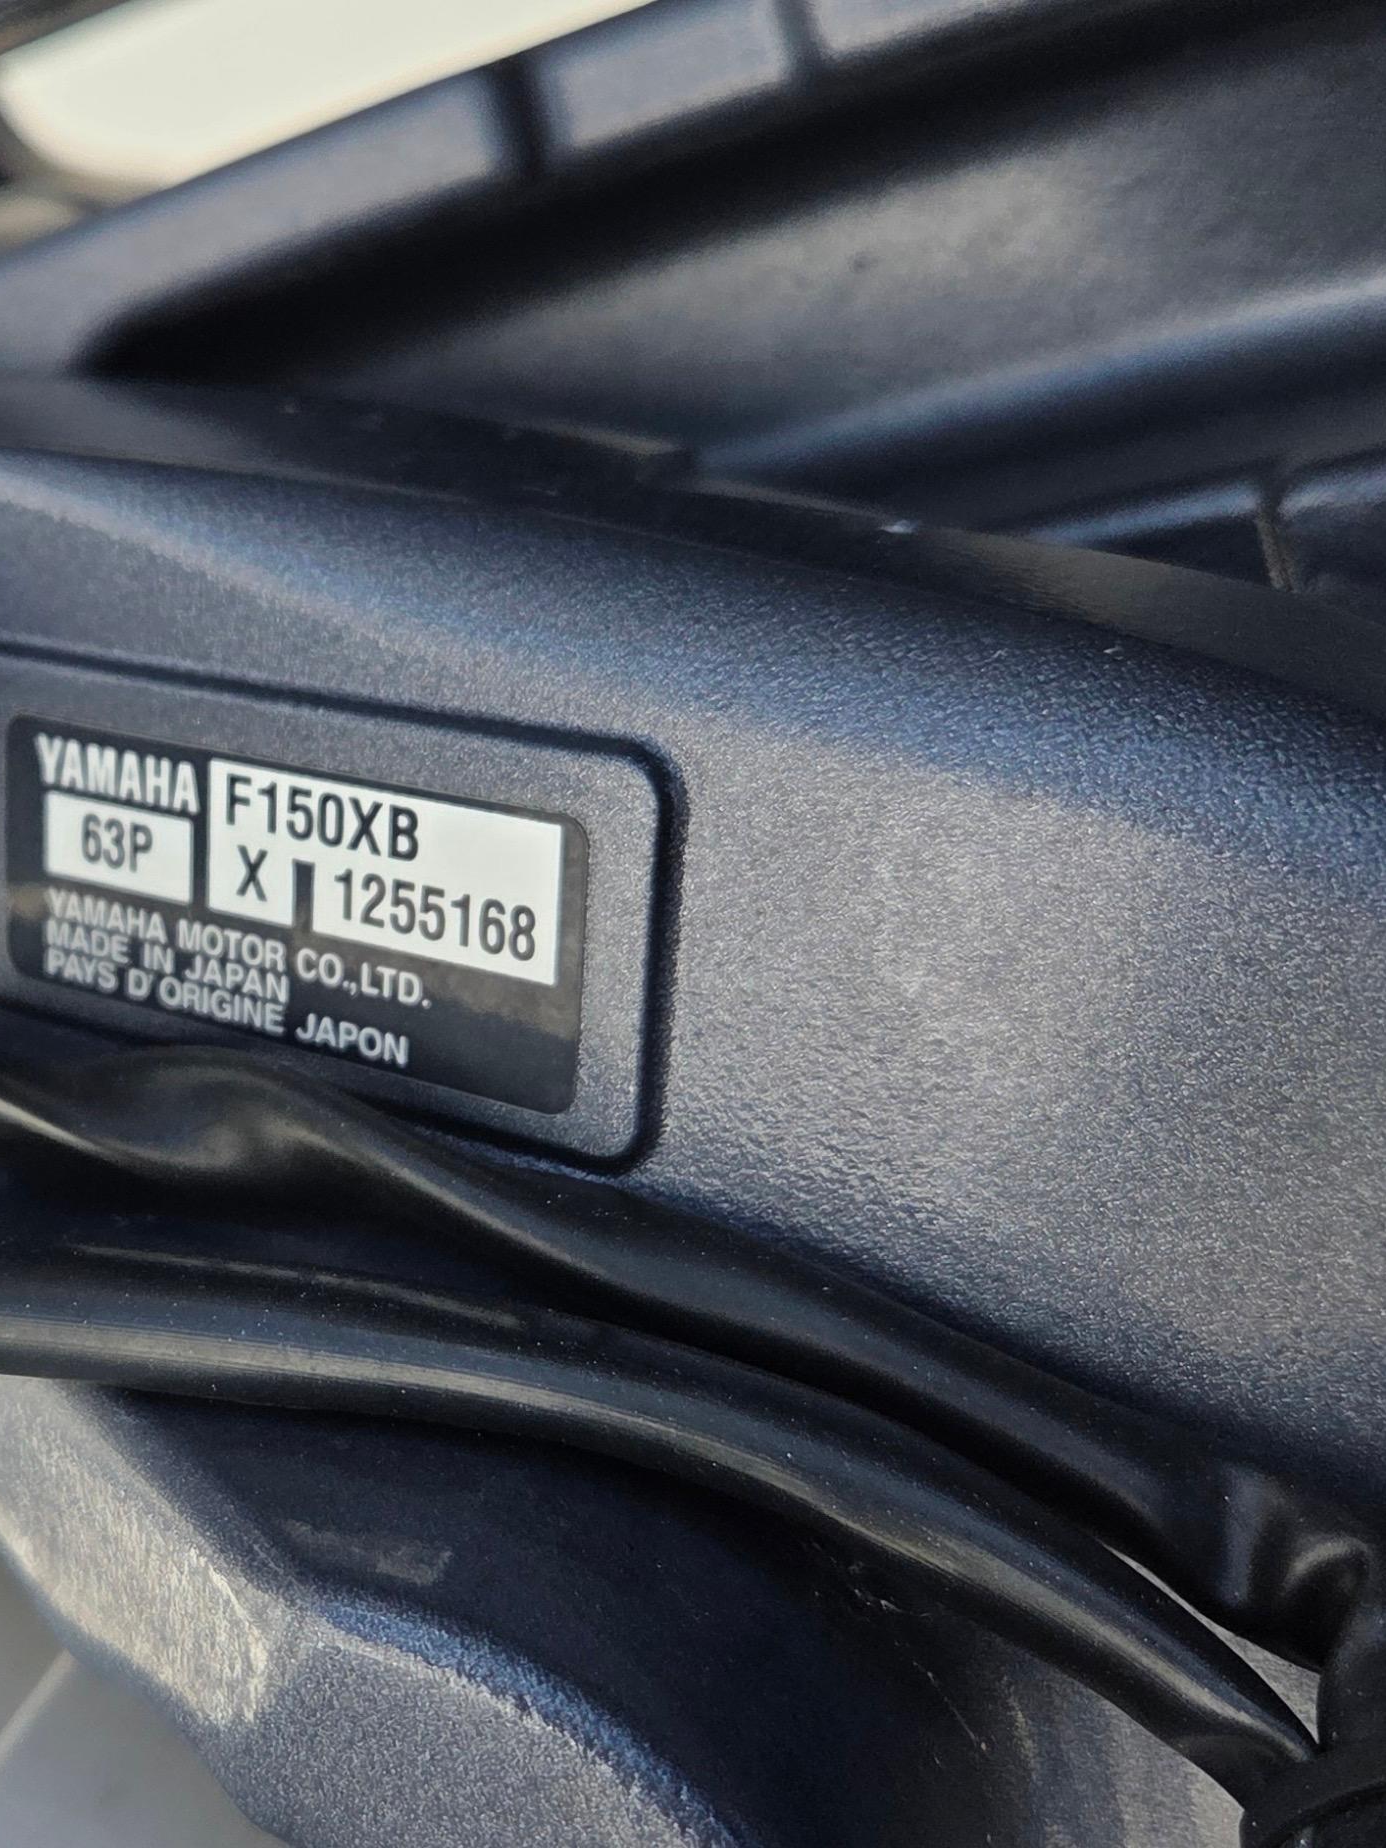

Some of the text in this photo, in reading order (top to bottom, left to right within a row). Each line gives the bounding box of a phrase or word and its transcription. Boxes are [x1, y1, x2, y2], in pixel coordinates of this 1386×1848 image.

[35, 733, 200, 814] YAMAHA
[81, 812, 153, 873] 63P
[226, 774, 419, 860] F150XB
[45, 887, 167, 943] YAMAHA
[177, 918, 287, 972] MOTOR
[236, 845, 536, 961] X 1255168
[46, 919, 290, 1003] MADE IN JAPAN
[45, 948, 116, 991] PAYS
[296, 1013, 410, 1066] JAPON
